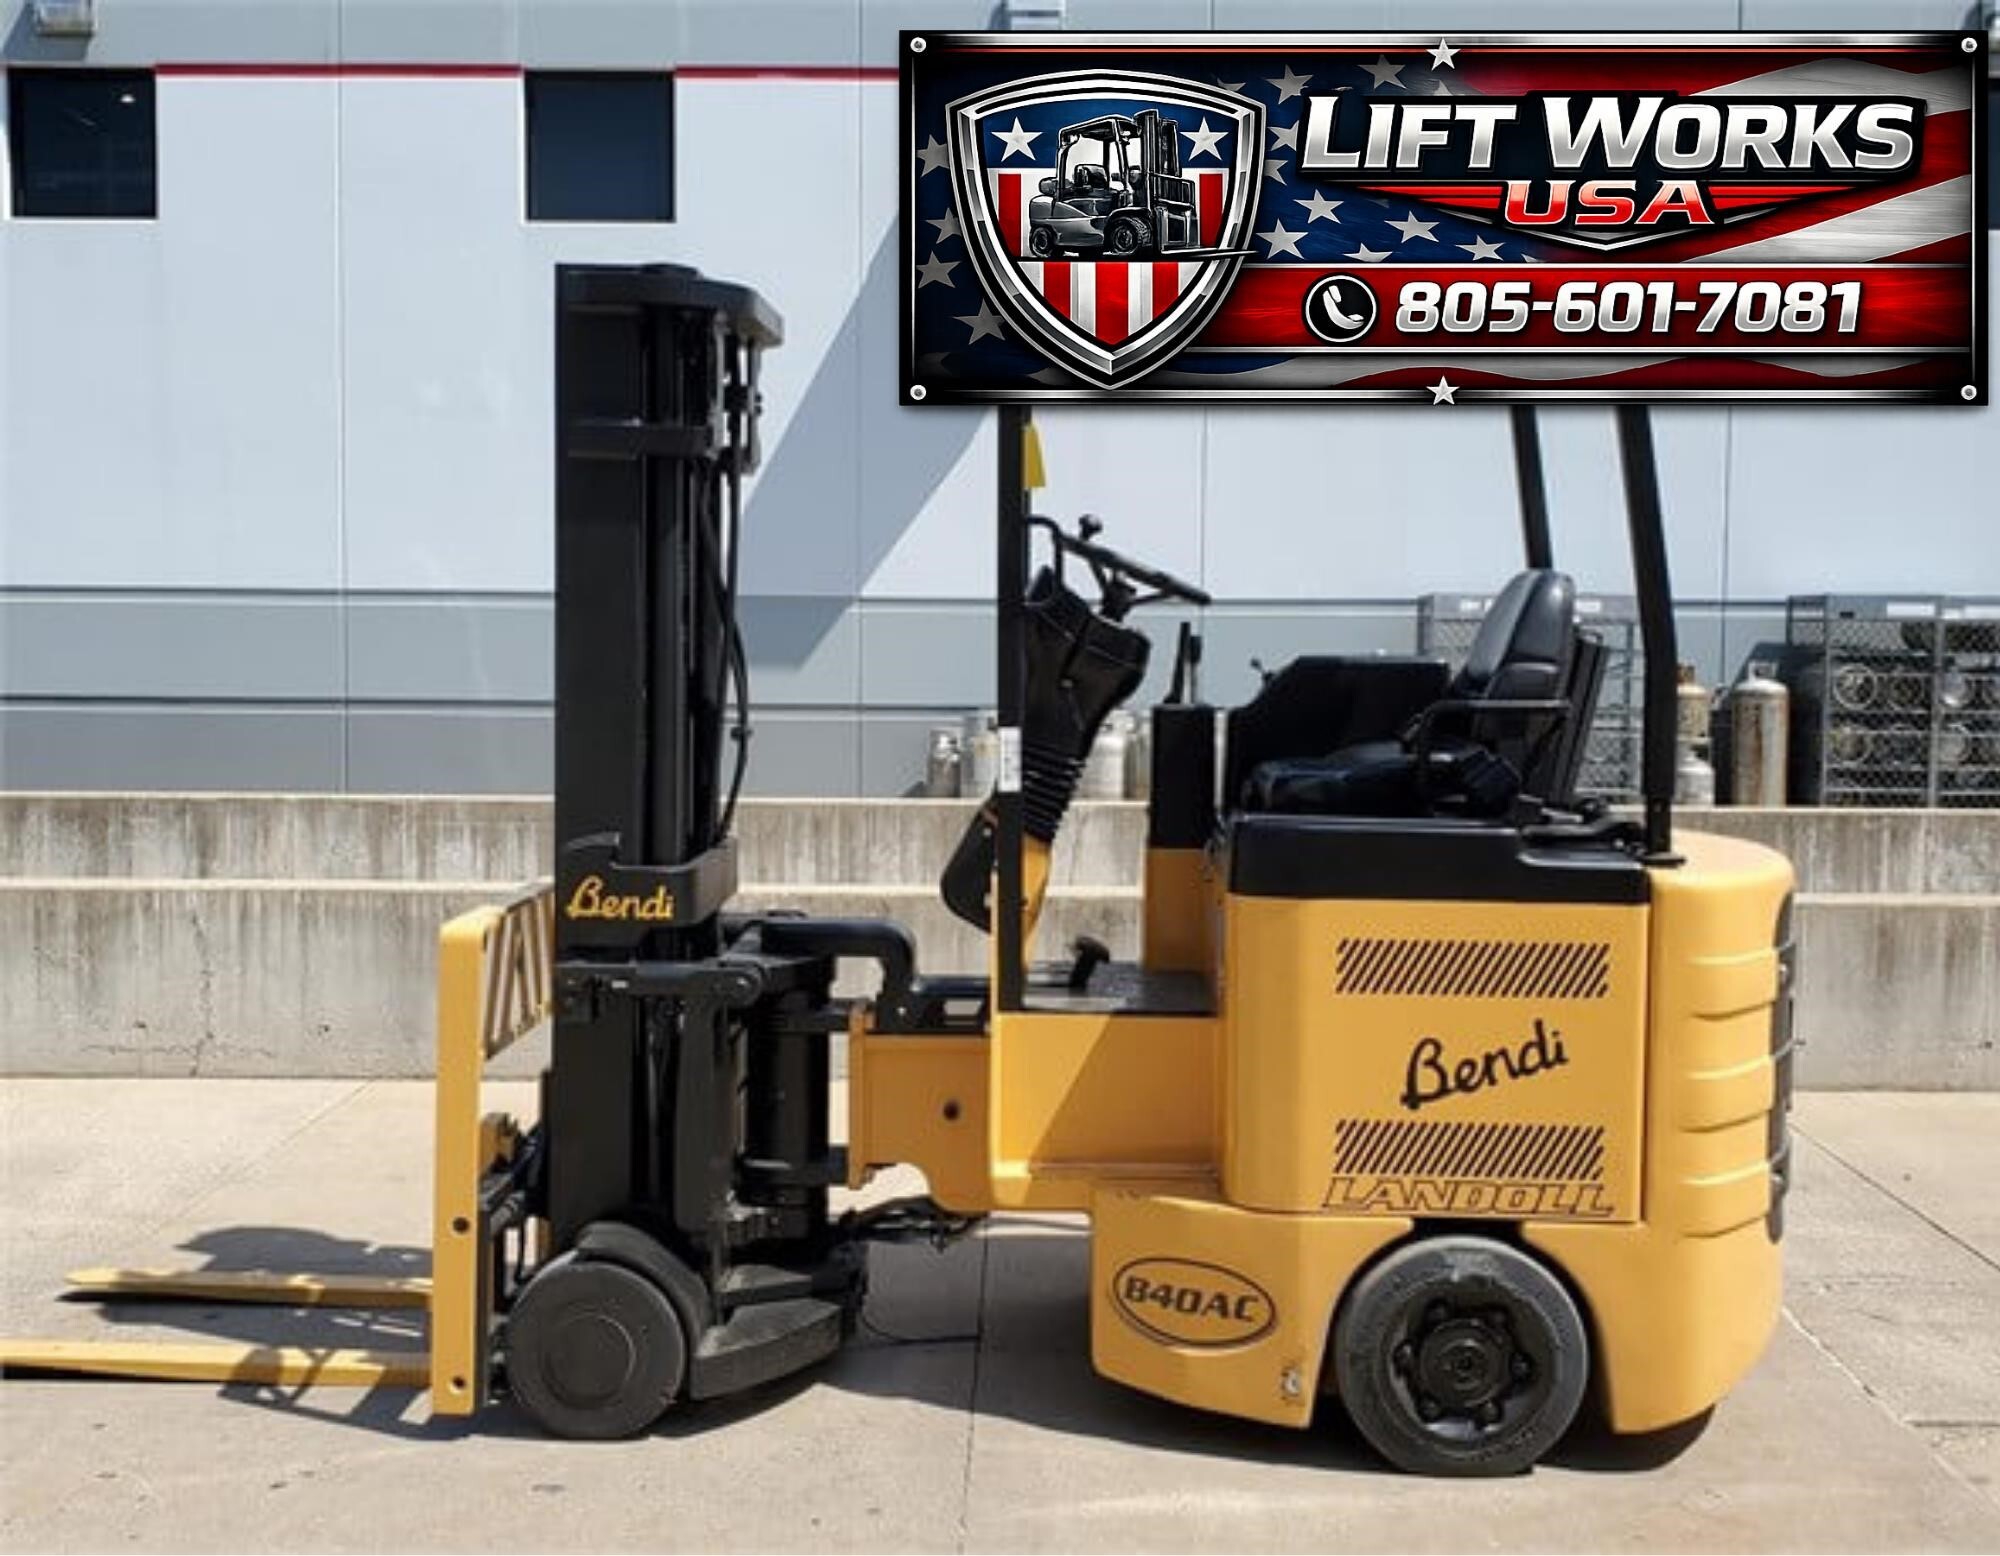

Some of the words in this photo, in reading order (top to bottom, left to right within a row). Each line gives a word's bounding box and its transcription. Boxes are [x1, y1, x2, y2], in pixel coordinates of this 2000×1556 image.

[566, 874, 675, 919] Bendi
[1400, 1018, 1568, 1110] Bendi
[1322, 1177, 1614, 1216] LANDOLL
